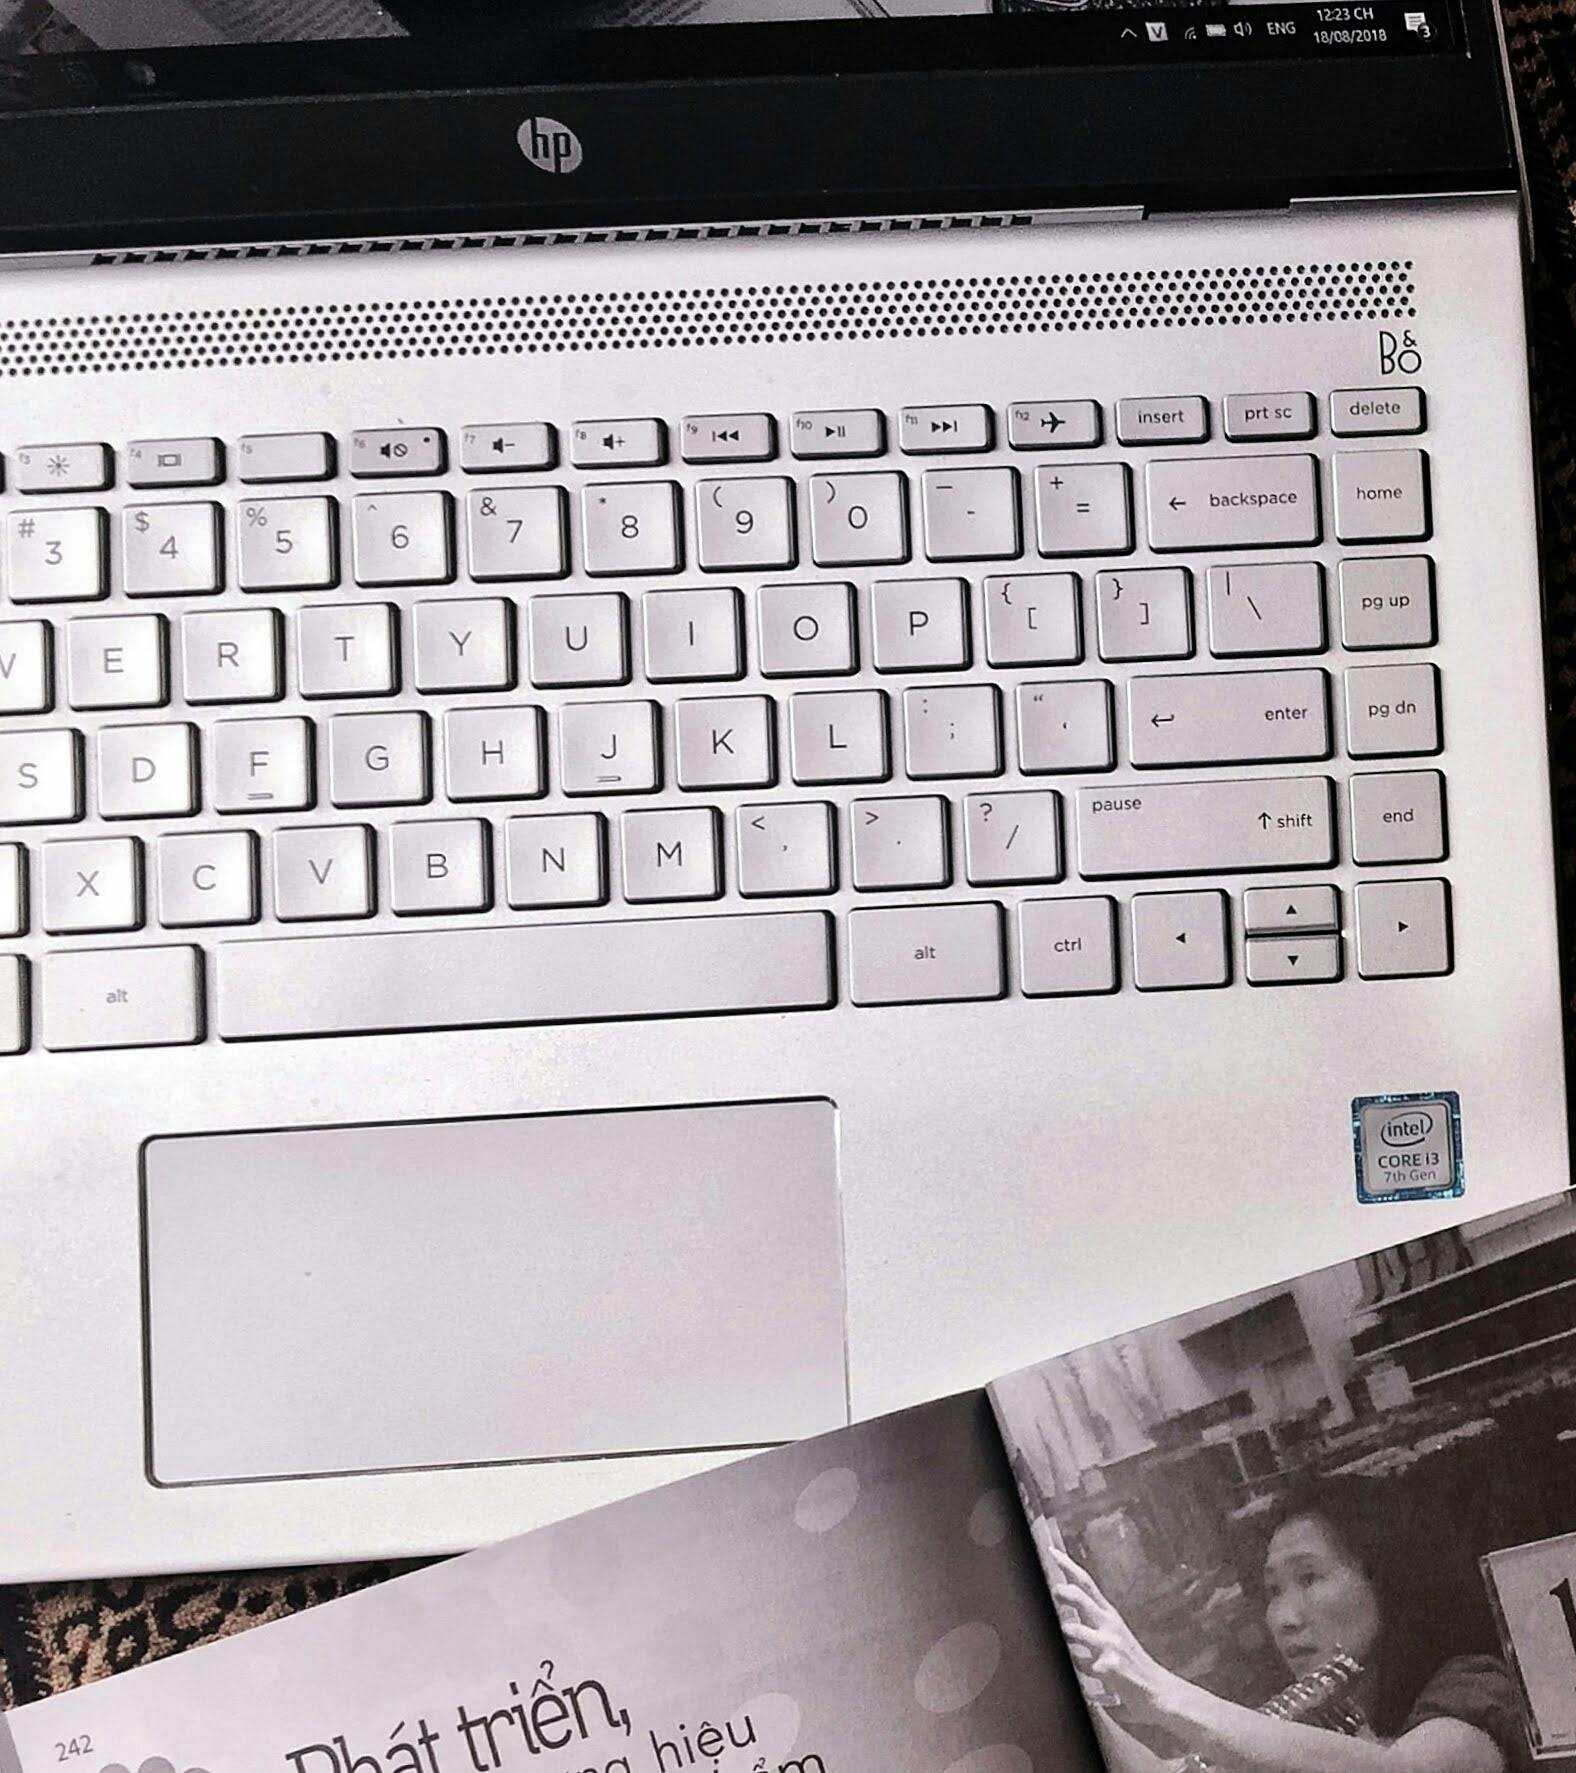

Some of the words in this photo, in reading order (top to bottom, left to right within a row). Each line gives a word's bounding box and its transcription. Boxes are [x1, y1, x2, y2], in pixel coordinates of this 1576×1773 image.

[1316, 8, 1351, 21] 12:23
[1353, 7, 1374, 20] CH
[1266, 21, 1296, 35] ENG
[1313, 29, 1387, 45] 18/08/2018
[1421, 24, 1431, 38] 3
[529, 116, 572, 174] hp
[1138, 410, 1184, 424] insert
[1244, 406, 1269, 423] prt
[1274, 407, 1292, 419] sc
[1349, 401, 1401, 416] delete
[686, 423, 699, 435] f9
[1049, 476, 1064, 490] +
[1356, 487, 1403, 500] home
[480, 496, 497, 517] &
[1076, 502, 1090, 513] =
[1209, 492, 1297, 508] backspace
[18, 518, 36, 539] #
[134, 510, 150, 534] $
[245, 507, 268, 527] %
[621, 514, 639, 539] 8
[735, 510, 754, 535] 9
[275, 529, 293, 554] 5
[391, 524, 409, 549] 6
[506, 519, 523, 543] 7
[44, 540, 63, 566] 3
[158, 535, 179, 559] 4
[1362, 596, 1384, 611] pg
[1389, 595, 1410, 609] up
[909, 610, 929, 636] P
[334, 636, 355, 662] T
[449, 631, 472, 657] Y
[565, 625, 588, 652] U
[103, 647, 124, 674] E
[217, 641, 239, 668] R
[1264, 707, 1308, 721] enter
[1368, 704, 1390, 718] pg
[1395, 700, 1417, 715] dn
[600, 734, 617, 760] J
[712, 728, 734, 755] K
[829, 724, 848, 749] L
[250, 750, 269, 777] F
[365, 745, 389, 771] G
[482, 740, 504, 765] H
[18, 762, 38, 789] S
[131, 756, 156, 784] D
[979, 802, 993, 822] ?
[1092, 798, 1142, 814] pause
[1382, 808, 1414, 823] end
[1277, 813, 1313, 829] shift
[426, 853, 449, 879] B
[542, 847, 565, 873] N
[656, 841, 682, 868] M
[192, 864, 216, 891] C
[308, 858, 333, 885] V
[76, 870, 100, 898] X
[914, 945, 936, 960] alt
[1054, 937, 1082, 953] ctrl
[106, 988, 129, 1004] alt
[1387, 1118, 1424, 1137] intel
[1378, 1154, 1421, 1169] CORE
[1384, 1171, 1406, 1183] 7th
[1409, 1168, 1436, 1181] Gen
[457, 1659, 632, 1772] triển,
[55, 1734, 94, 1762] 242
